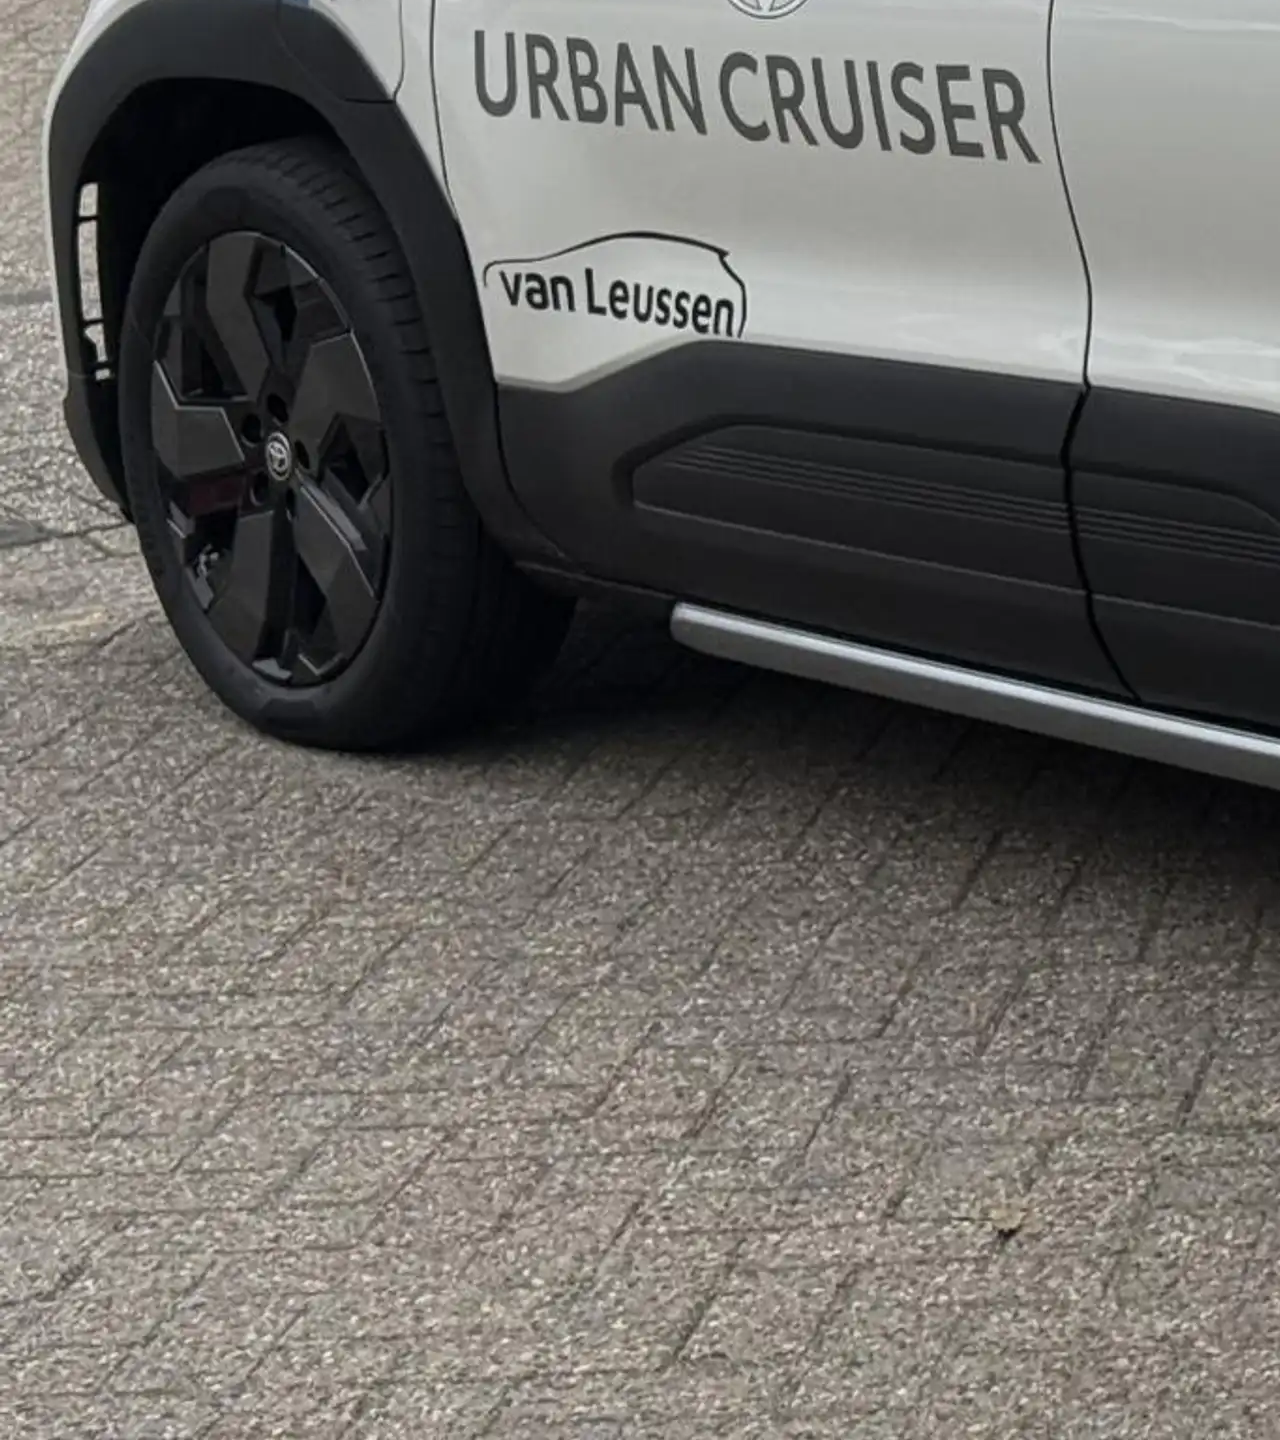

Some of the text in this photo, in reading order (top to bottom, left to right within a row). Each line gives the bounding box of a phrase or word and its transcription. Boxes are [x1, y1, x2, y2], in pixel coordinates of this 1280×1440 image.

[473, 29, 1042, 164] URBAN CRUISER
[499, 268, 735, 337] van Leussen
